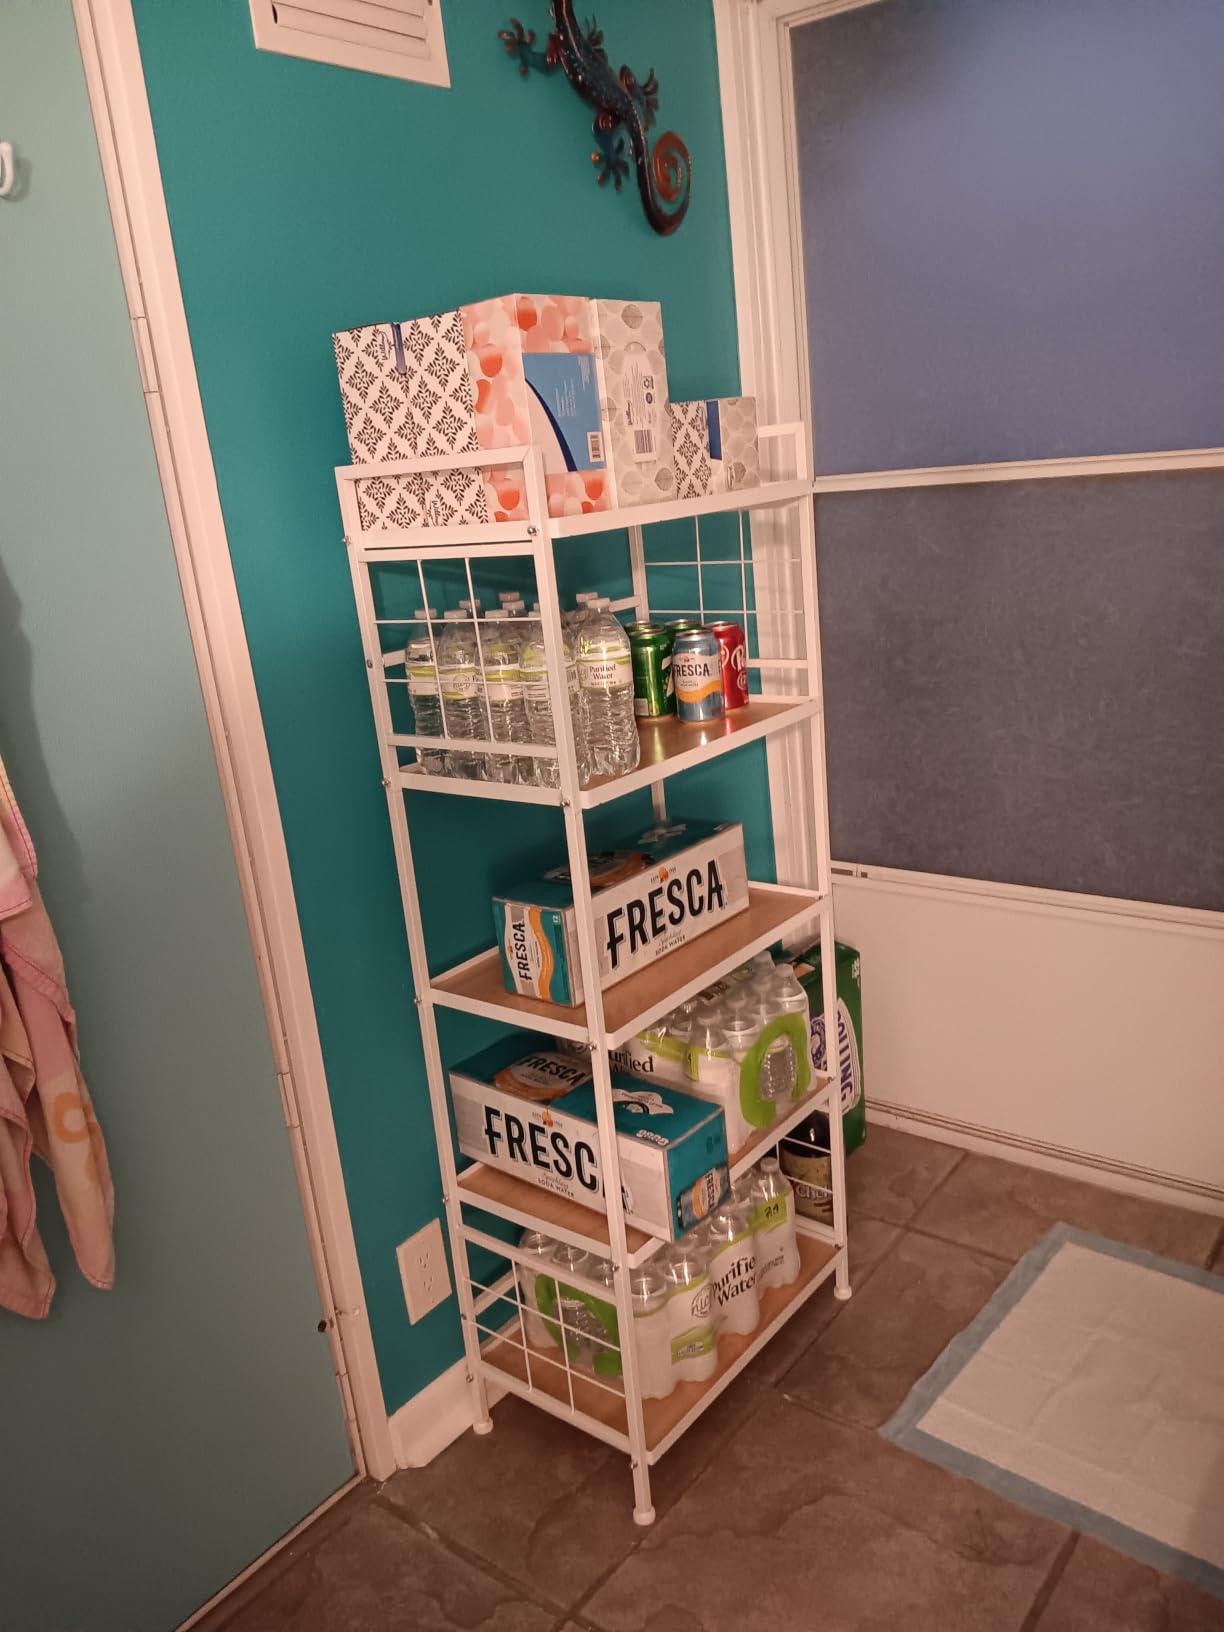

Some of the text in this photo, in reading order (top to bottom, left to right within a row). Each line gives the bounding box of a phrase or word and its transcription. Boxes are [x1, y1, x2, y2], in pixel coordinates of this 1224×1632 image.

[673, 662, 711, 677] FRESCA
[606, 858, 725, 969] FRESCA
[512, 921, 533, 981] FRESCA
[519, 1055, 586, 1086] FRESCA
[607, 1049, 653, 1073] urified
[712, 1254, 756, 1294] Purifie
